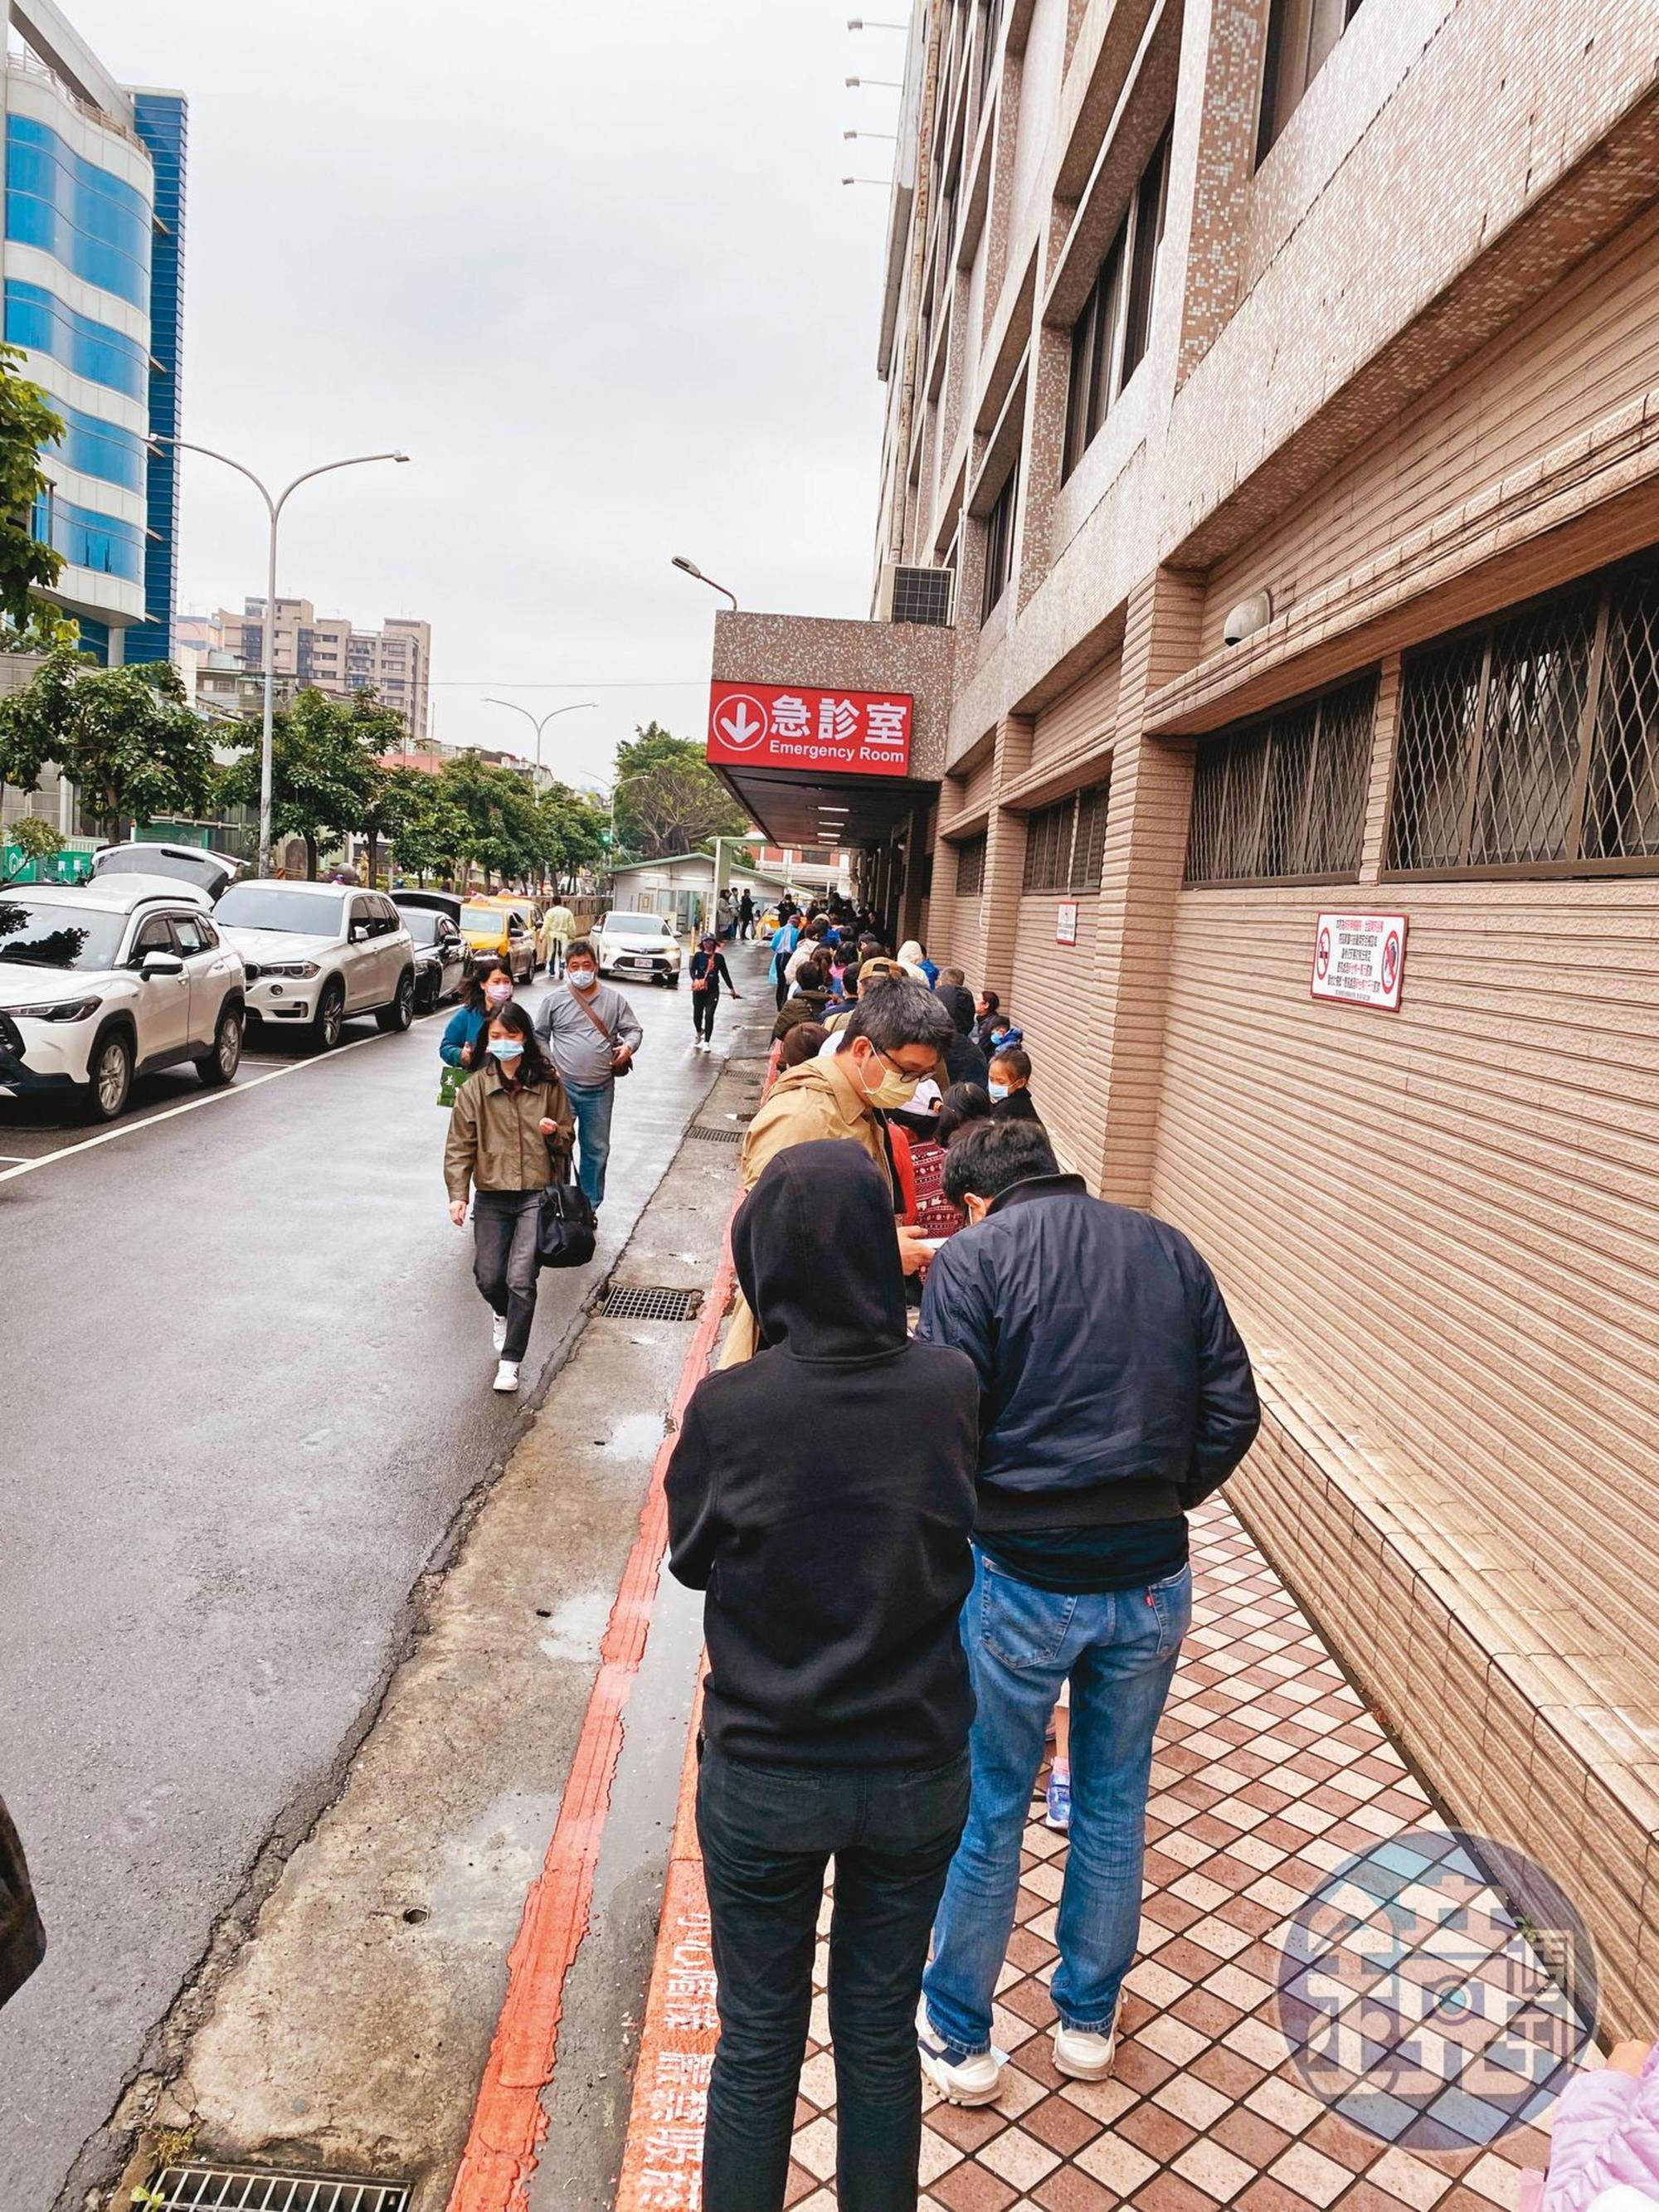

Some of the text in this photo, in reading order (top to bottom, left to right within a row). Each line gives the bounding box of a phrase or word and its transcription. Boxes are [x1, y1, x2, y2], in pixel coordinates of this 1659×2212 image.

[771, 695, 907, 745] 急診室
[770, 739, 904, 763] Emergency Room
